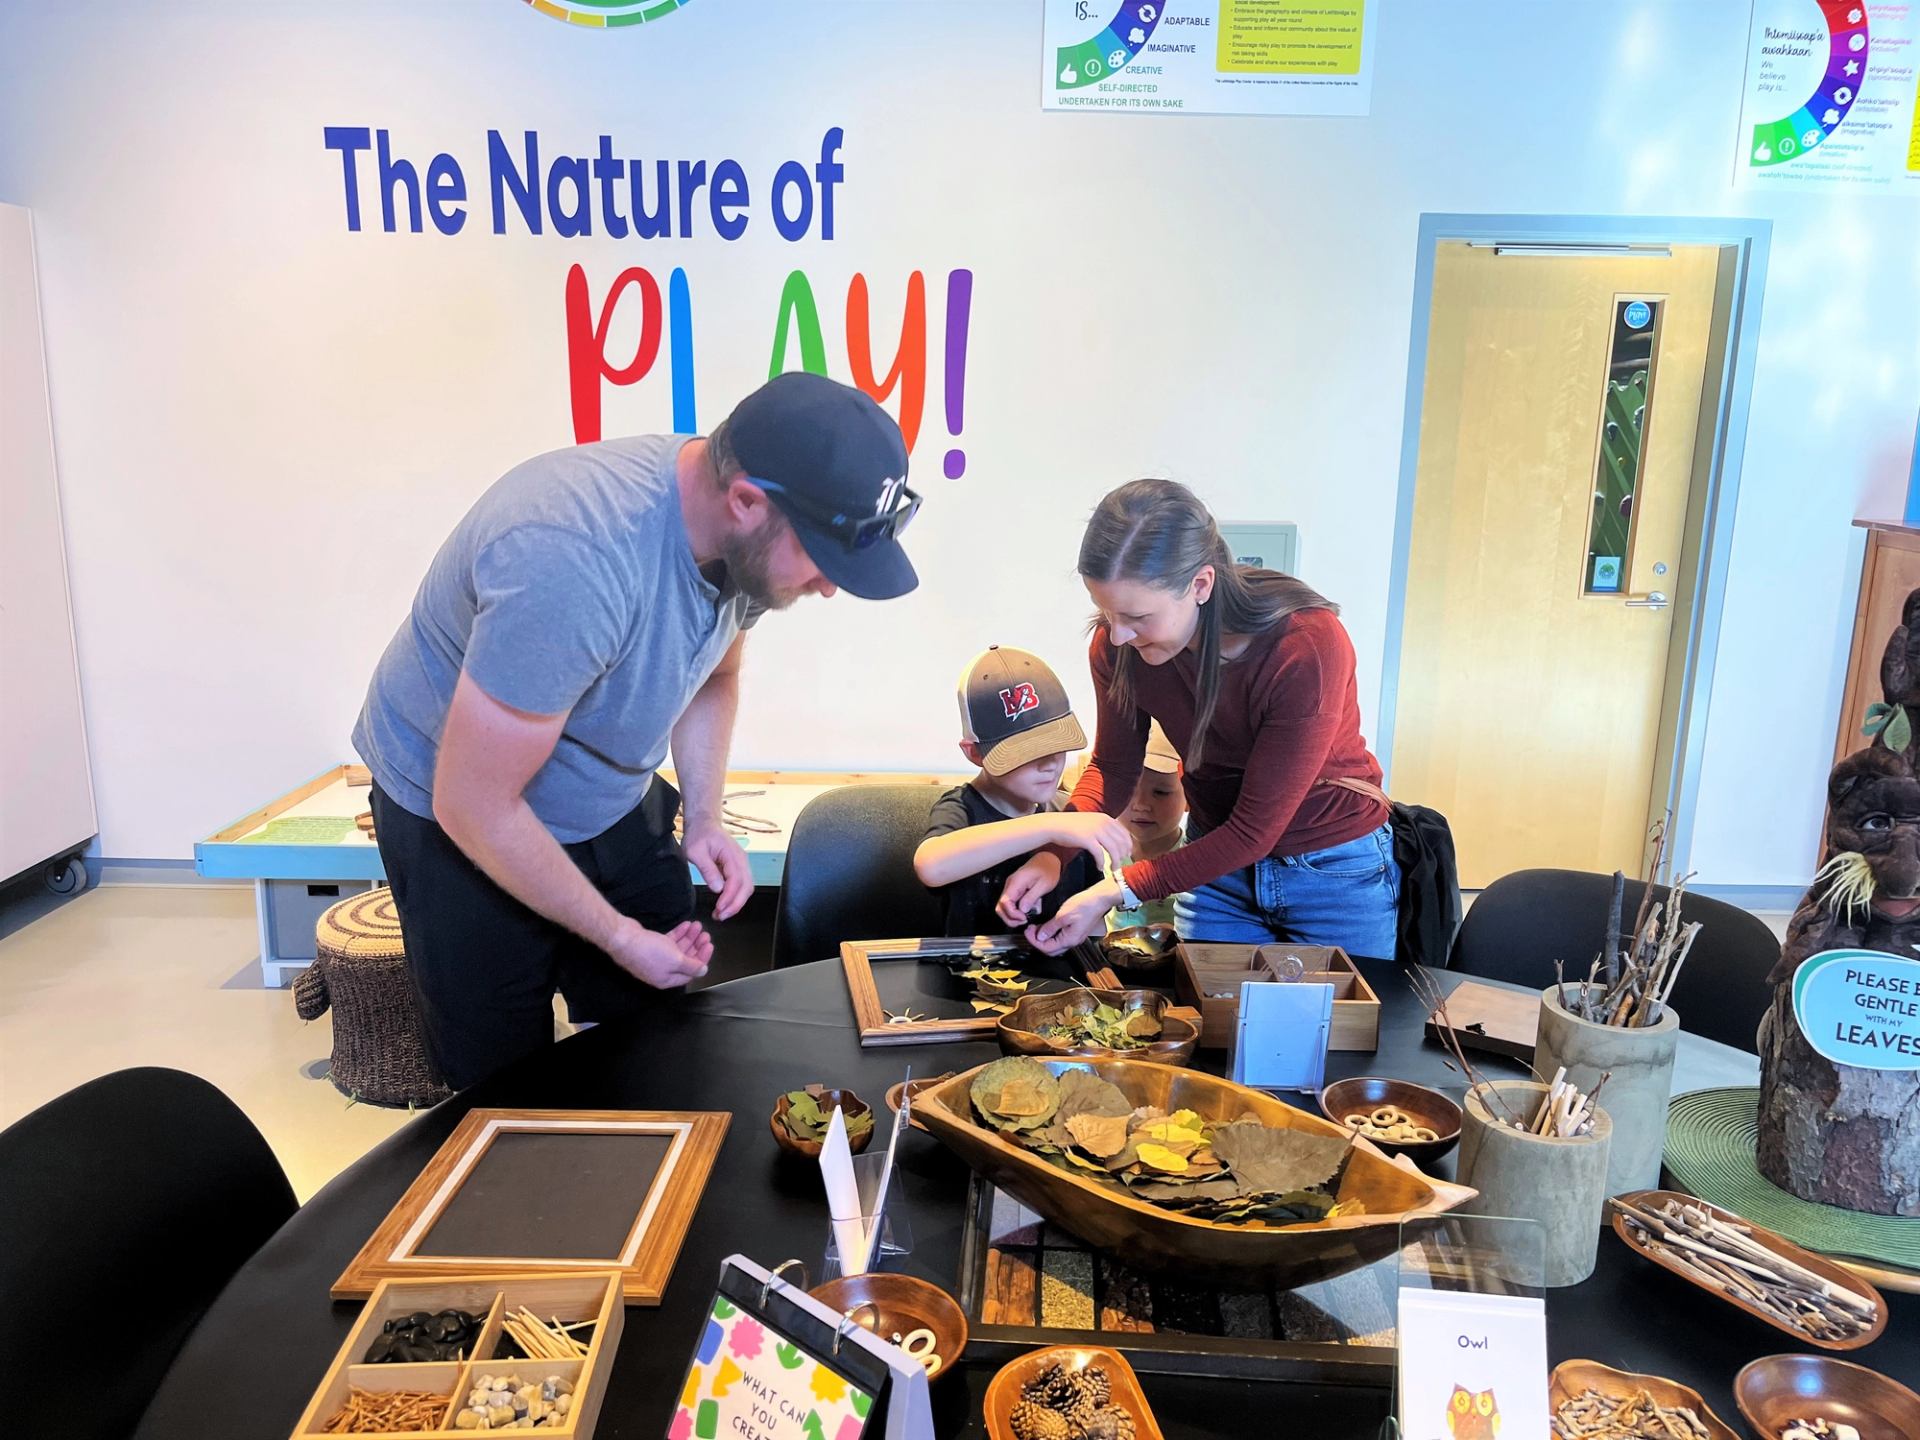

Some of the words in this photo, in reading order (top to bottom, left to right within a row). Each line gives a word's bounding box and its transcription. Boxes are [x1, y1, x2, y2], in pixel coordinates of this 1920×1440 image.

[1164, 17, 1210, 26] ADAPTABLE
[1147, 44, 1196, 53] IMAGINATIVE
[1125, 66, 1163, 75] CREATIVE
[1098, 83, 1158, 93] SELF-DIRECTED
[1058, 97, 1110, 106] UNDERTAKEN
[1111, 98, 1128, 107] FOR
[1129, 98, 1141, 107] ITS
[1142, 99, 1160, 107] OWN
[1162, 99, 1184, 108] SAKE
[323, 126, 467, 236] The
[487, 128, 750, 241] Nature
[771, 126, 845, 241] of
[1845, 969, 1910, 994] PLEASE
[1855, 993, 1919, 1017] GENTLE
[1865, 1014, 1887, 1025] WITH
[1889, 1019, 1903, 1028] MY
[1836, 1022, 1920, 1056] LEAVES
[1457, 1335, 1488, 1350] Owl
[742, 1371, 777, 1405] WHAT
[780, 1400, 806, 1425] CAN
[751, 1402, 778, 1430] YOU
